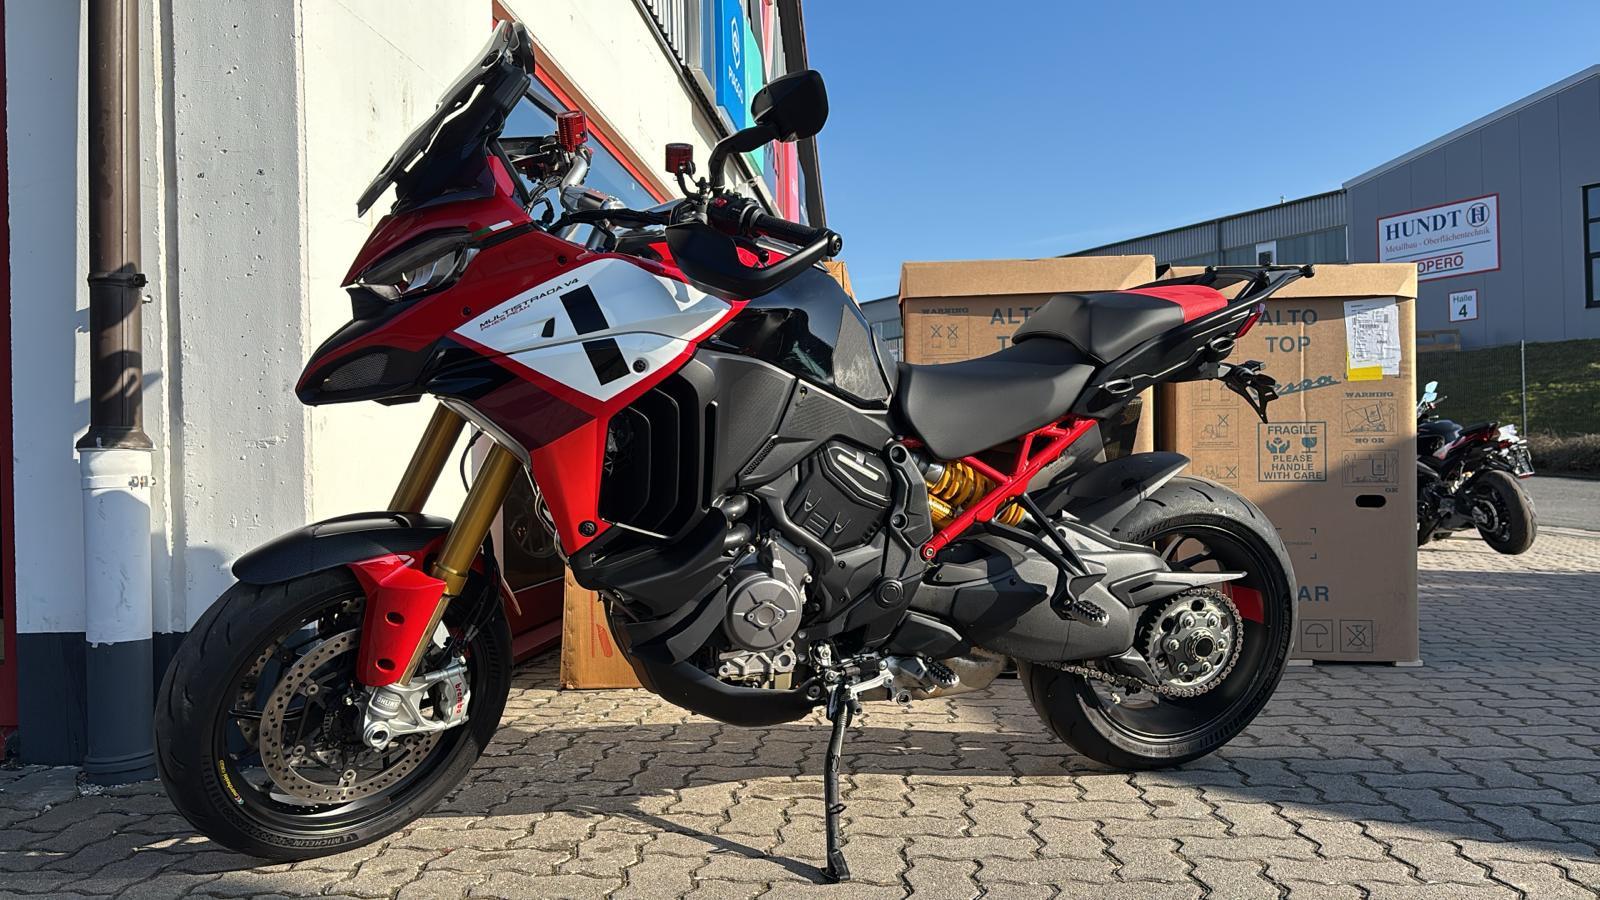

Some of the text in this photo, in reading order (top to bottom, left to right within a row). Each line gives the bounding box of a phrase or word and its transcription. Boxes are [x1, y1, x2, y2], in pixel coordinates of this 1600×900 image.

[1385, 209, 1462, 241] HUNDT
[1385, 242, 1418, 254] Metallbau
[479, 277, 579, 328] MULTISTRADA V4
[1453, 294, 1473, 303] Halle
[990, 306, 1042, 325] ALT
[1258, 309, 1318, 326] ALTO
[1458, 304, 1468, 318] 4
[1265, 336, 1311, 353] TOP
[1267, 425, 1318, 435] FRAGILE
[1272, 454, 1313, 462] PLEASE
[1271, 463, 1314, 471] HANDLE
[1263, 471, 1322, 480] WITH CARE
[455, 682, 463, 714] brembo
[293, 837, 341, 847] MICHELIN
